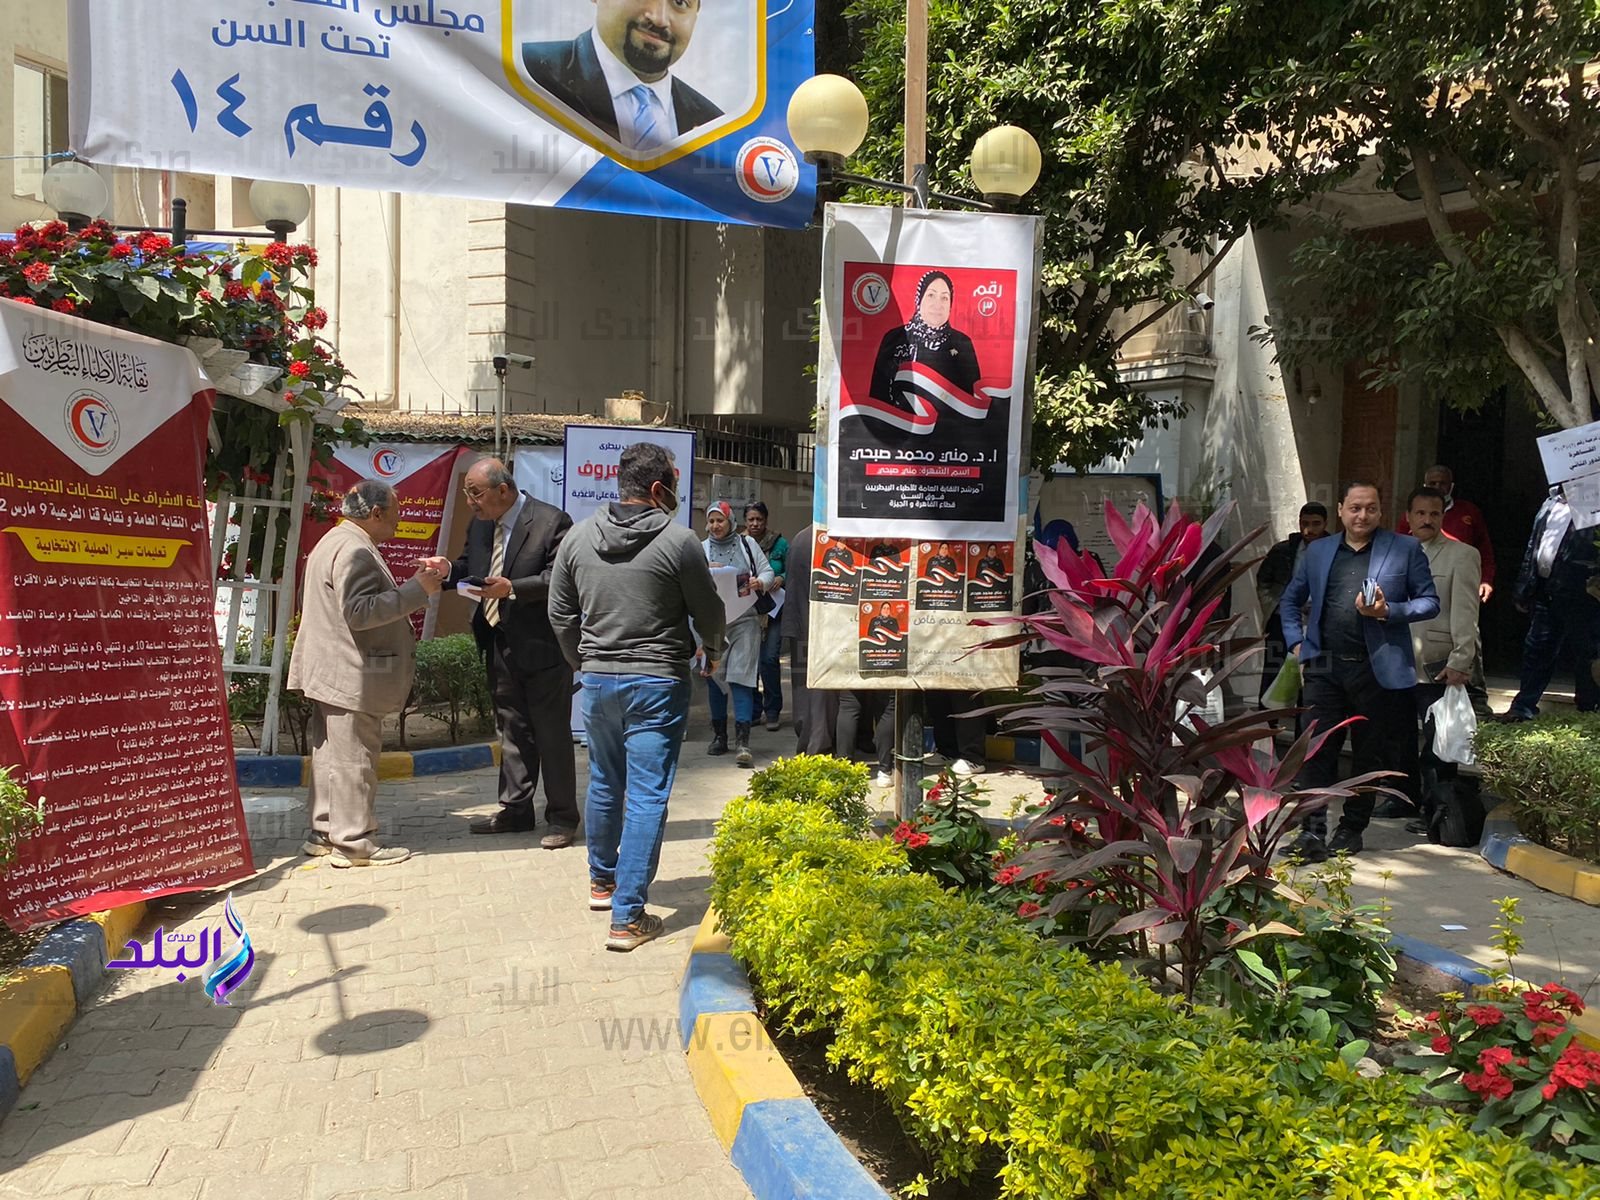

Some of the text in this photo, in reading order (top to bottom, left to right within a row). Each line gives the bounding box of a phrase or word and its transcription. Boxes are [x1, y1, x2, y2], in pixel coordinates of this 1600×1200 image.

[211, 17, 390, 59] تحت السن
[170, 67, 427, 167] رقم ١٤
[973, 281, 1003, 297] رقم
[849, 448, 891, 463] صبحي
[895, 449, 934, 462] محمد
[951, 468, 970, 477] اسم
[17, 478, 63, 495] التجديد
[66, 482, 117, 500] انتخابات
[120, 489, 140, 505] على
[10, 501, 36, 517] مارس
[39, 502, 47, 516] 9
[49, 502, 85, 522] الفرعية
[89, 506, 101, 521] قنا
[102, 508, 124, 526] نقابة
[133, 511, 158, 526] العامة
[160, 514, 188, 530] النقابة
[83, 540, 112, 557] العملية
[116, 548, 133, 559] سير
[136, 545, 167, 560] تعليمات
[14, 573, 41, 587] الاقتراع
[58, 575, 76, 587] داخل
[5, 608, 124, 622] الكمامة الطبية مراعاة التباعد
[32, 643, 60, 656] الابواب
[62, 642, 79, 655] تغلق
[95, 641, 102, 652] 6
[135, 640, 145, 650] 10
[25, 661, 47, 676] الذي
[48, 660, 84, 673] بالتصويت
[86, 659, 100, 671] لهم
[48, 695, 76, 708] الناخبين
[78, 691, 103, 705] بكشوف
[17, 701, 40, 710] مسدد
[169, 700, 187, 712] 2021
[26, 730, 63, 746] شخصيته
[64, 728, 80, 742] يثبت
[81, 729, 88, 738] ما
[89, 725, 109, 739] تقديم
[111, 725, 119, 738] مع
[22, 757, 131, 784] بالتصويت بموجب تقديم إيصال
[89, 811, 111, 825] مستوى
[113, 807, 122, 820] كل
[45, 822, 61, 835] على
[62, 815, 88, 833] انتخابي
[117, 823, 127, 836] لكل
[70, 831, 94, 849] انتخابي
[95, 828, 115, 841] مستوى
[65, 852, 87, 866] عملية
[89, 845, 109, 859] متابعة
[44, 857, 63, 872] الفرز
[101, 861, 115, 872] عنه
[115, 855, 136, 870] مندوبا
[12, 863, 36, 879] للمرشح
[59, 869, 87, 886] المقيدين
[89, 865, 100, 879] من
[34, 875, 58, 892] بكشوف
[7, 883, 33, 900] الناخبين
[59, 889, 74, 902] فقط
[17, 899, 42, 913] الرقابة
[44, 896, 58, 908] على
